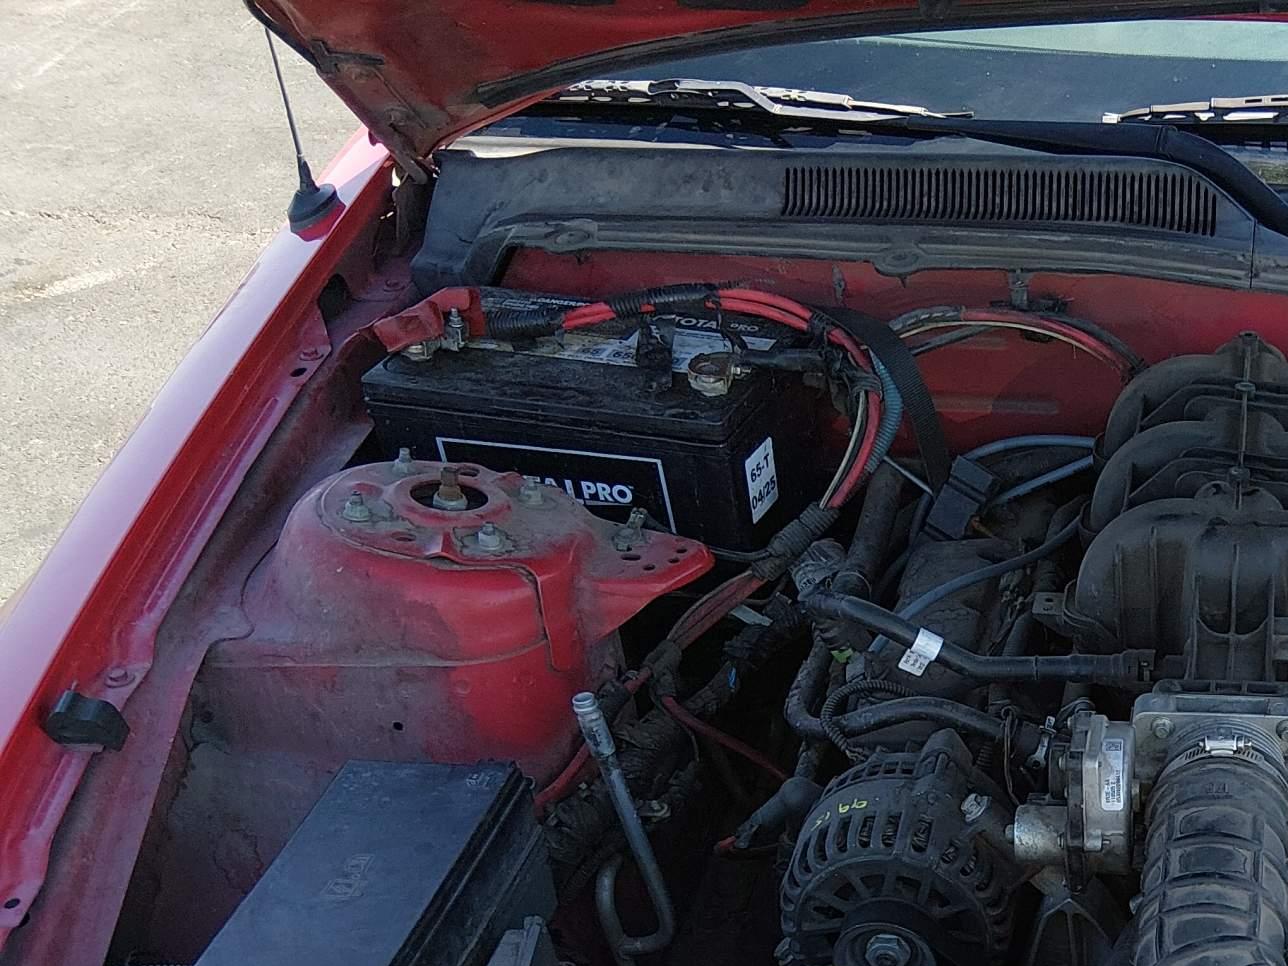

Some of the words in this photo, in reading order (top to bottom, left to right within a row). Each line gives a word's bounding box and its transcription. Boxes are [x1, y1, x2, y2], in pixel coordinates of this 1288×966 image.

[673, 315, 721, 331] TOTA
[750, 452, 770, 483] 65-T
[580, 480, 634, 504] PRO
[751, 475, 776, 510] 04/25
